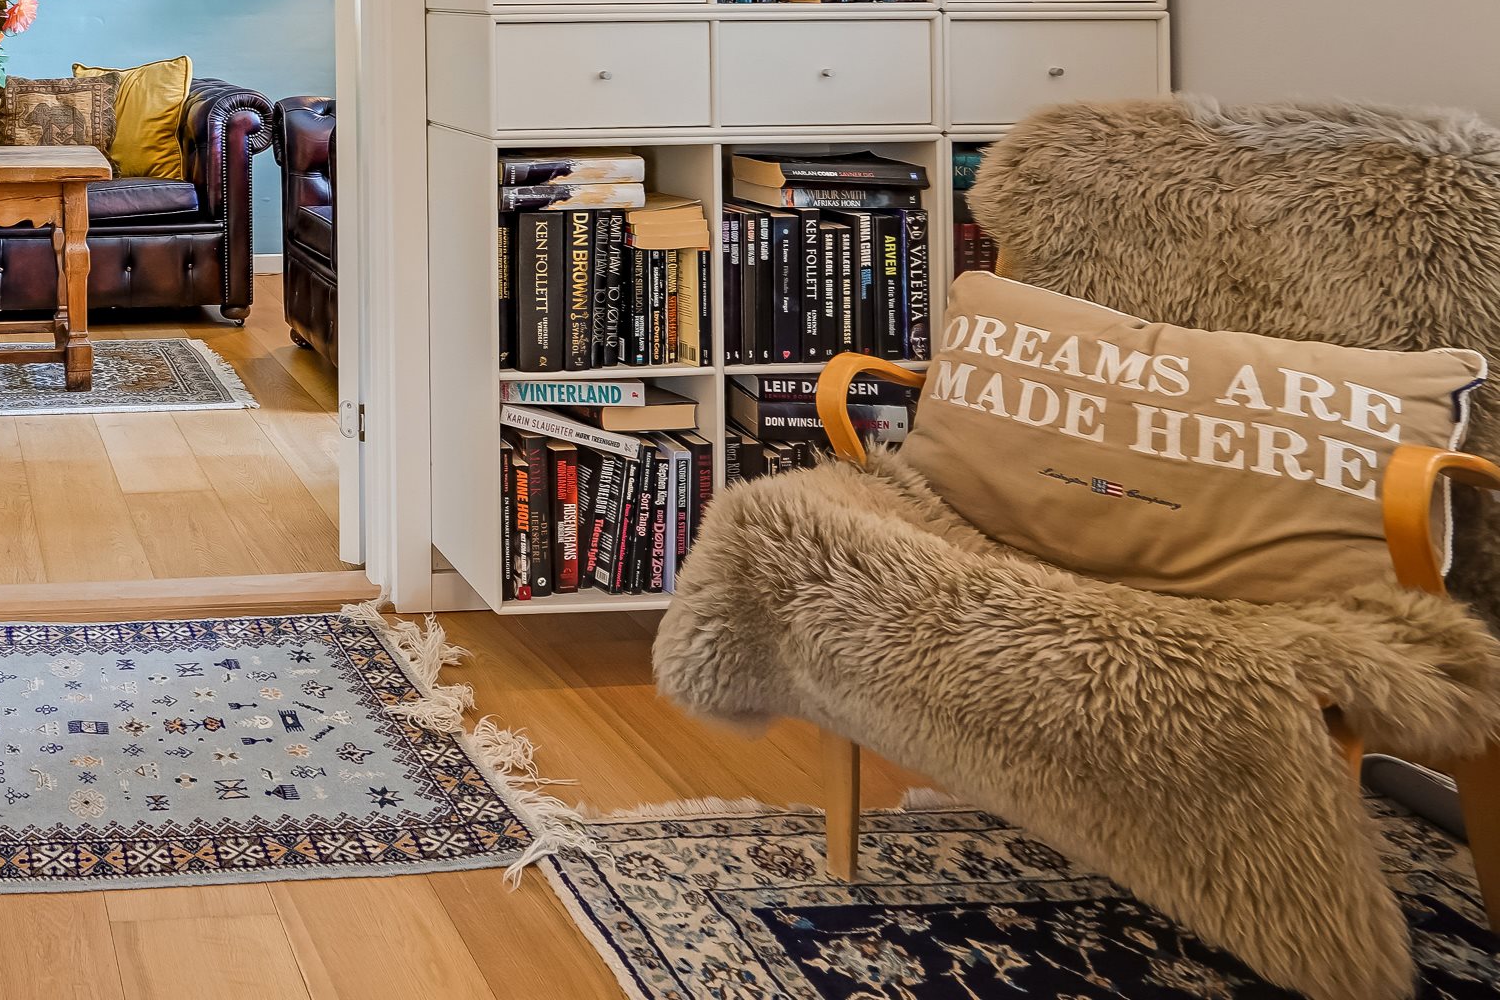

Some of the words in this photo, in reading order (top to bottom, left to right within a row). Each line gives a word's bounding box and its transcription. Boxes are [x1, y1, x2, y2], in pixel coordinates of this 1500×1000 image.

[536, 221, 547, 249] KEN
[573, 212, 588, 246] DAN
[806, 220, 816, 243] KEN
[885, 236, 896, 275] ARVEN
[536, 254, 548, 313] FOLLETT
[572, 249, 588, 309] BROWN
[807, 249, 816, 300] FOLLETT
[910, 246, 922, 321] VALERIA
[517, 383, 622, 403] VINTERLAND
[1215, 364, 1401, 443] ARE
[507, 411, 530, 426] KARIN
[531, 420, 574, 437] SLAUGHTER
[930, 361, 1107, 443] MADE
[1128, 401, 1377, 501] HERE
[517, 470, 528, 502] ANNE
[641, 493, 650, 509] Sort
[518, 503, 529, 532] HOLT
[563, 504, 576, 560] ROSENKRANS
[637, 512, 648, 536] Tango
[653, 523, 665, 556] DØDE
[652, 559, 664, 588] ZONE
